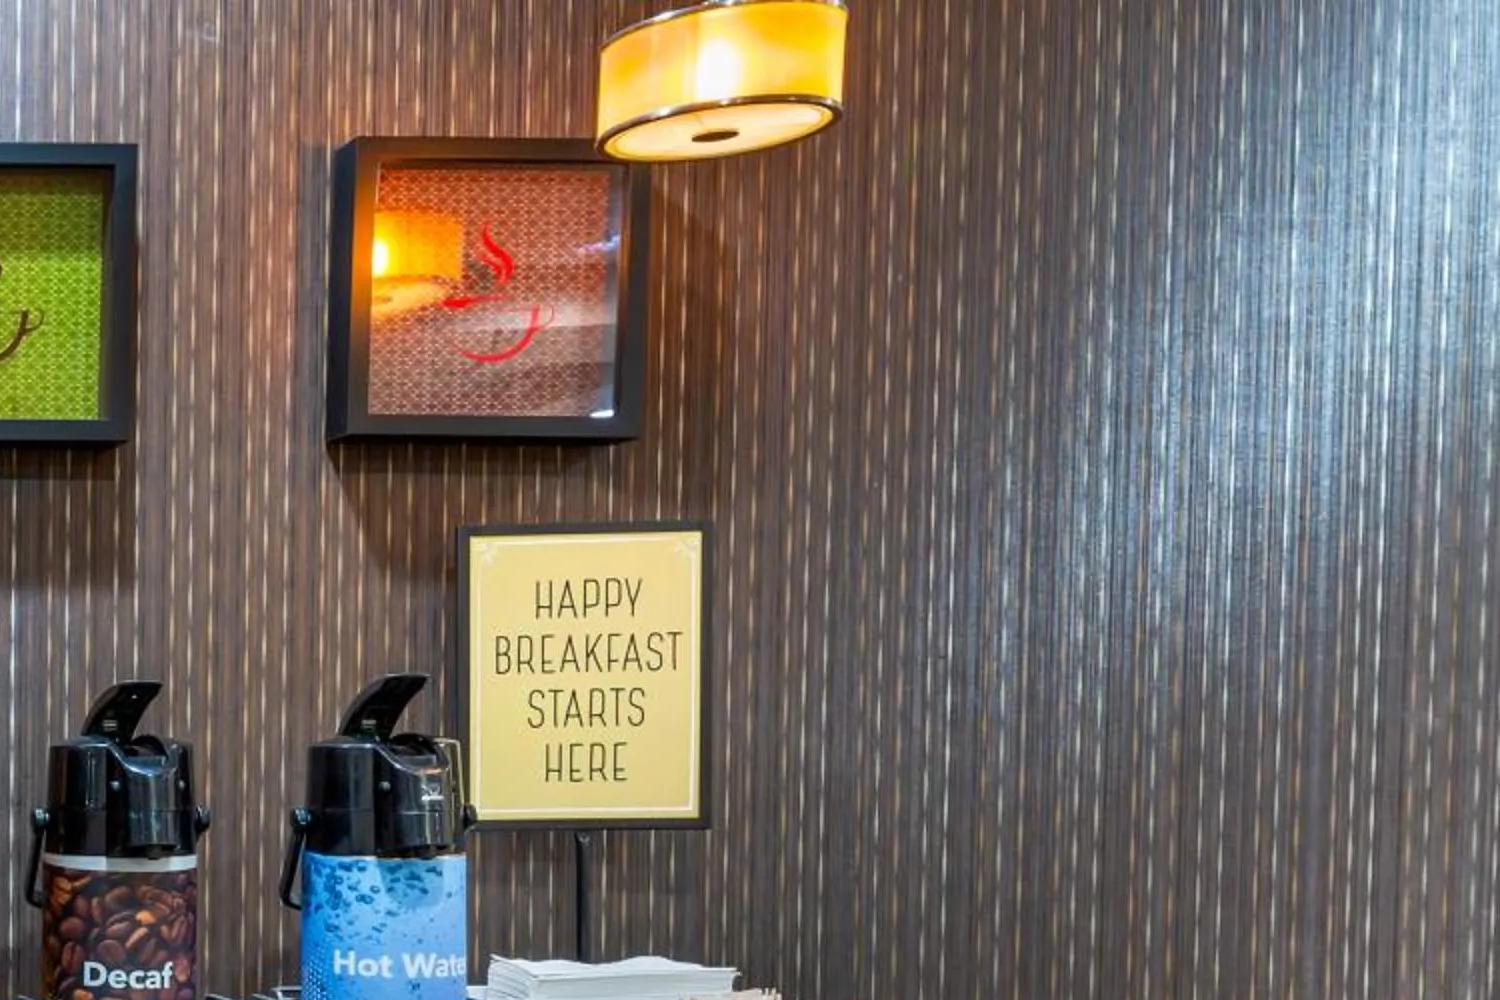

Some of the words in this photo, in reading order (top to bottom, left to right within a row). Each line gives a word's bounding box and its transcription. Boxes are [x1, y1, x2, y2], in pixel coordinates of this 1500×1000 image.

[535, 577, 643, 620] HAPPY
[494, 631, 684, 675] BREAKFAST
[527, 687, 646, 729] STARTS
[545, 741, 628, 783] HERE
[83, 961, 174, 989] Decaf
[333, 949, 394, 979] Hot
[402, 952, 467, 979] Wate
